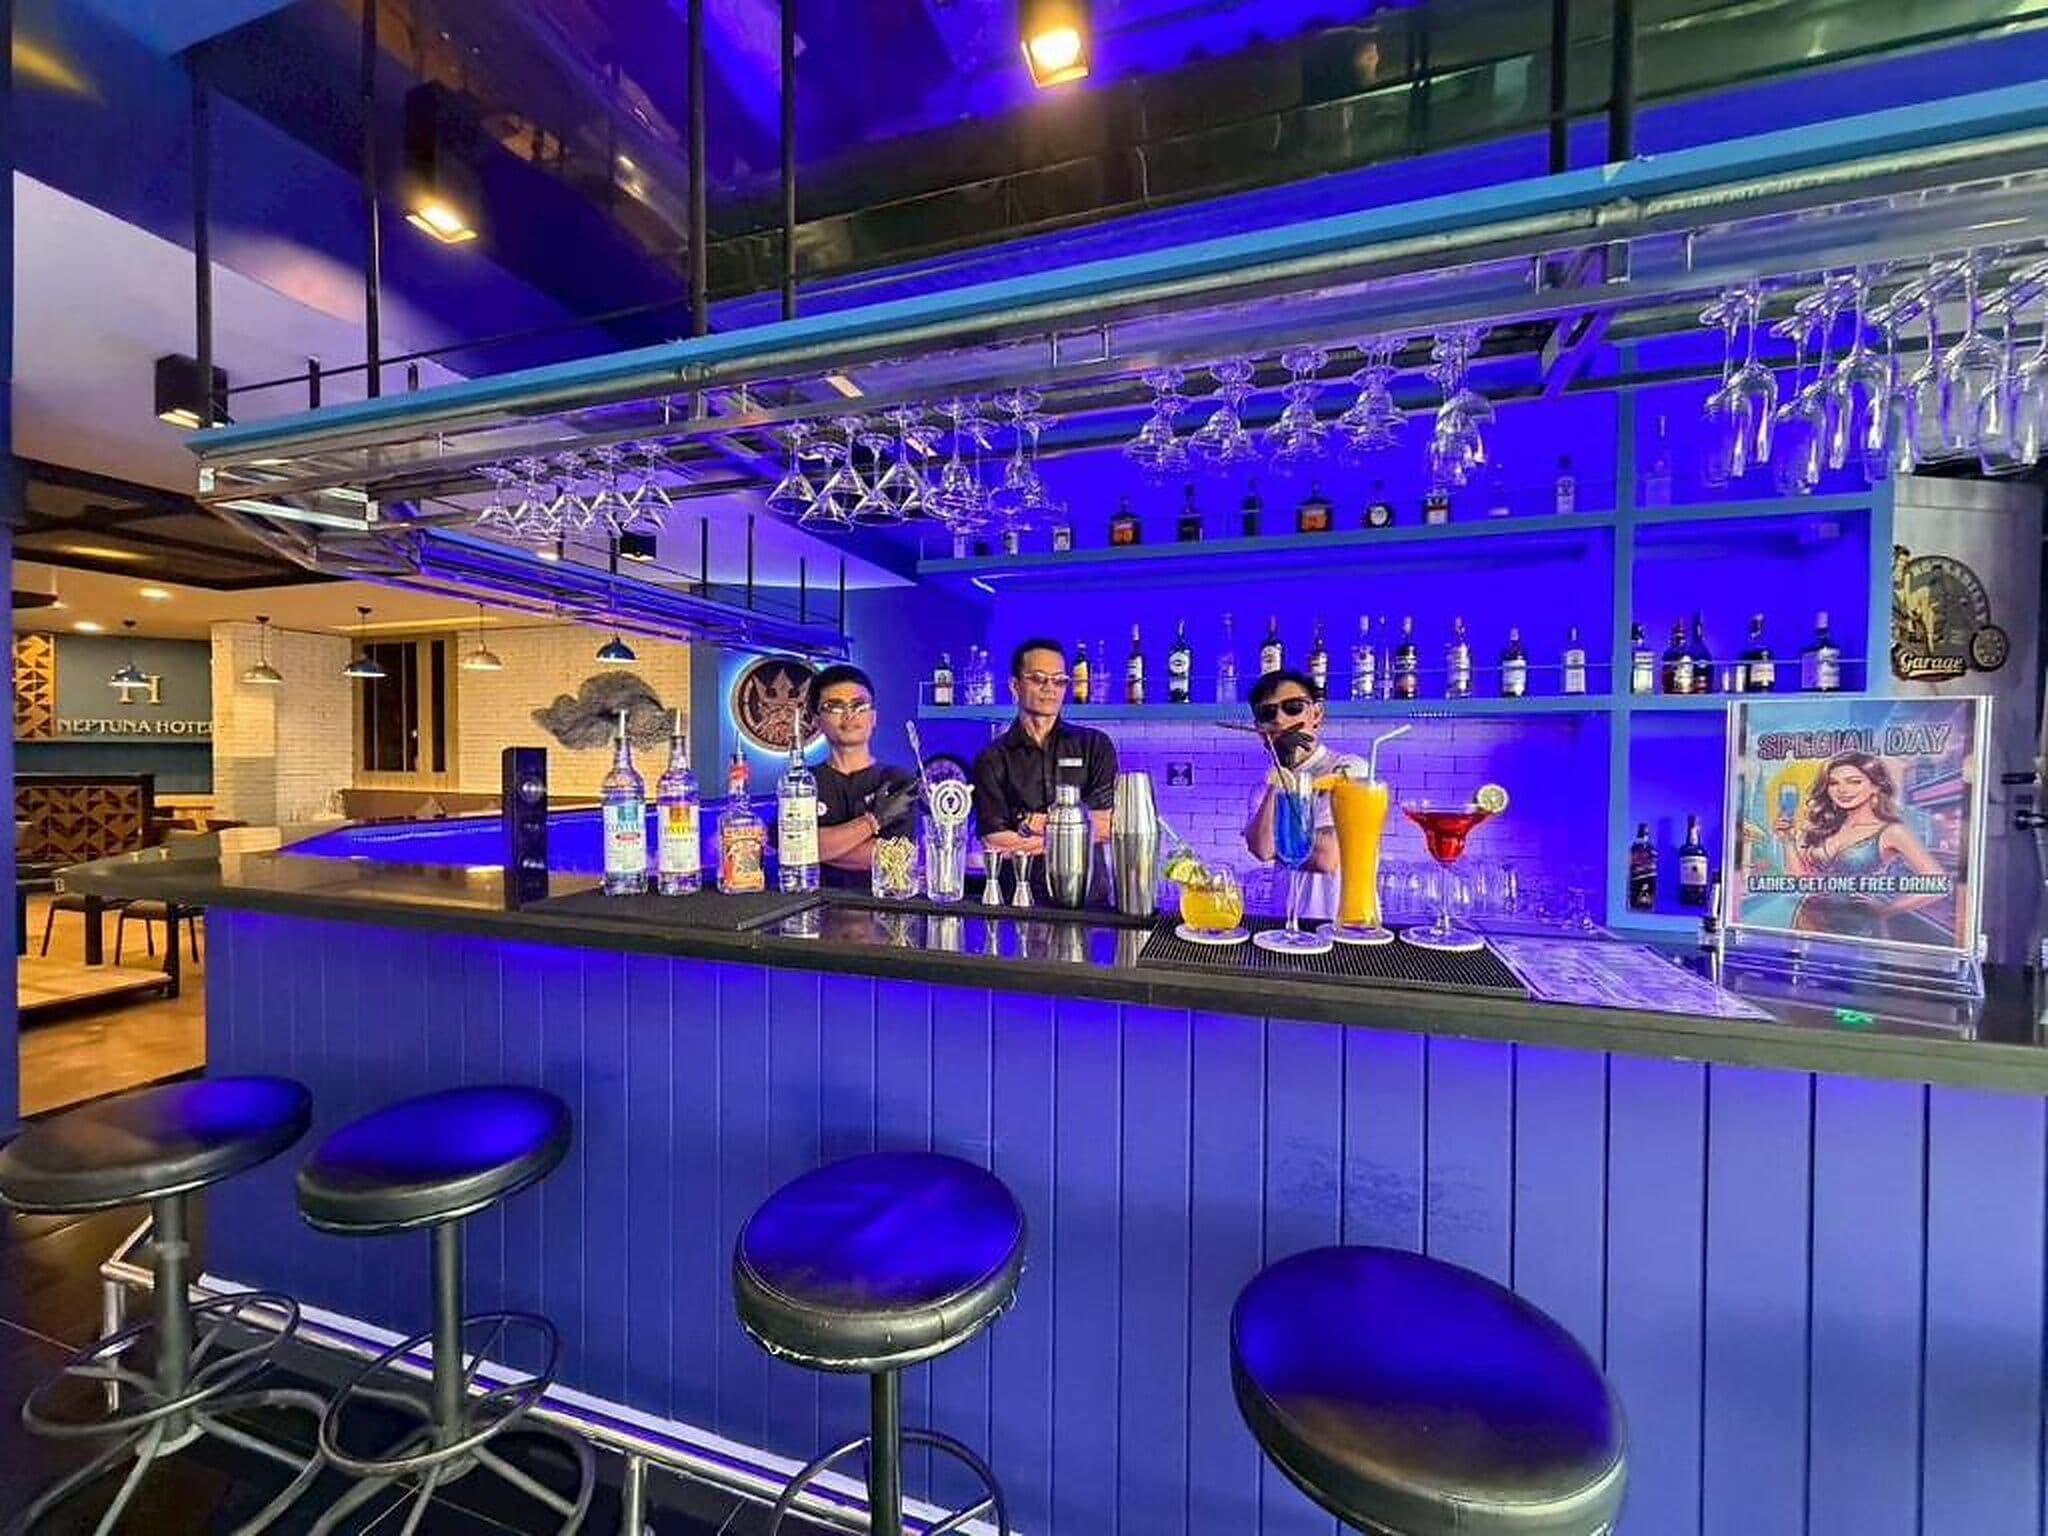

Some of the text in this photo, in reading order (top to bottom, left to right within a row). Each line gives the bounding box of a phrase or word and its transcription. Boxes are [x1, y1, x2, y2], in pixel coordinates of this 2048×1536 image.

[1900, 653, 1963, 673] Garage
[57, 719, 151, 734] NEPTUNA
[1758, 724, 1950, 760] SPECIAL DAY
[1749, 875, 1948, 893] LADIES GET ONE FREE DRINK
